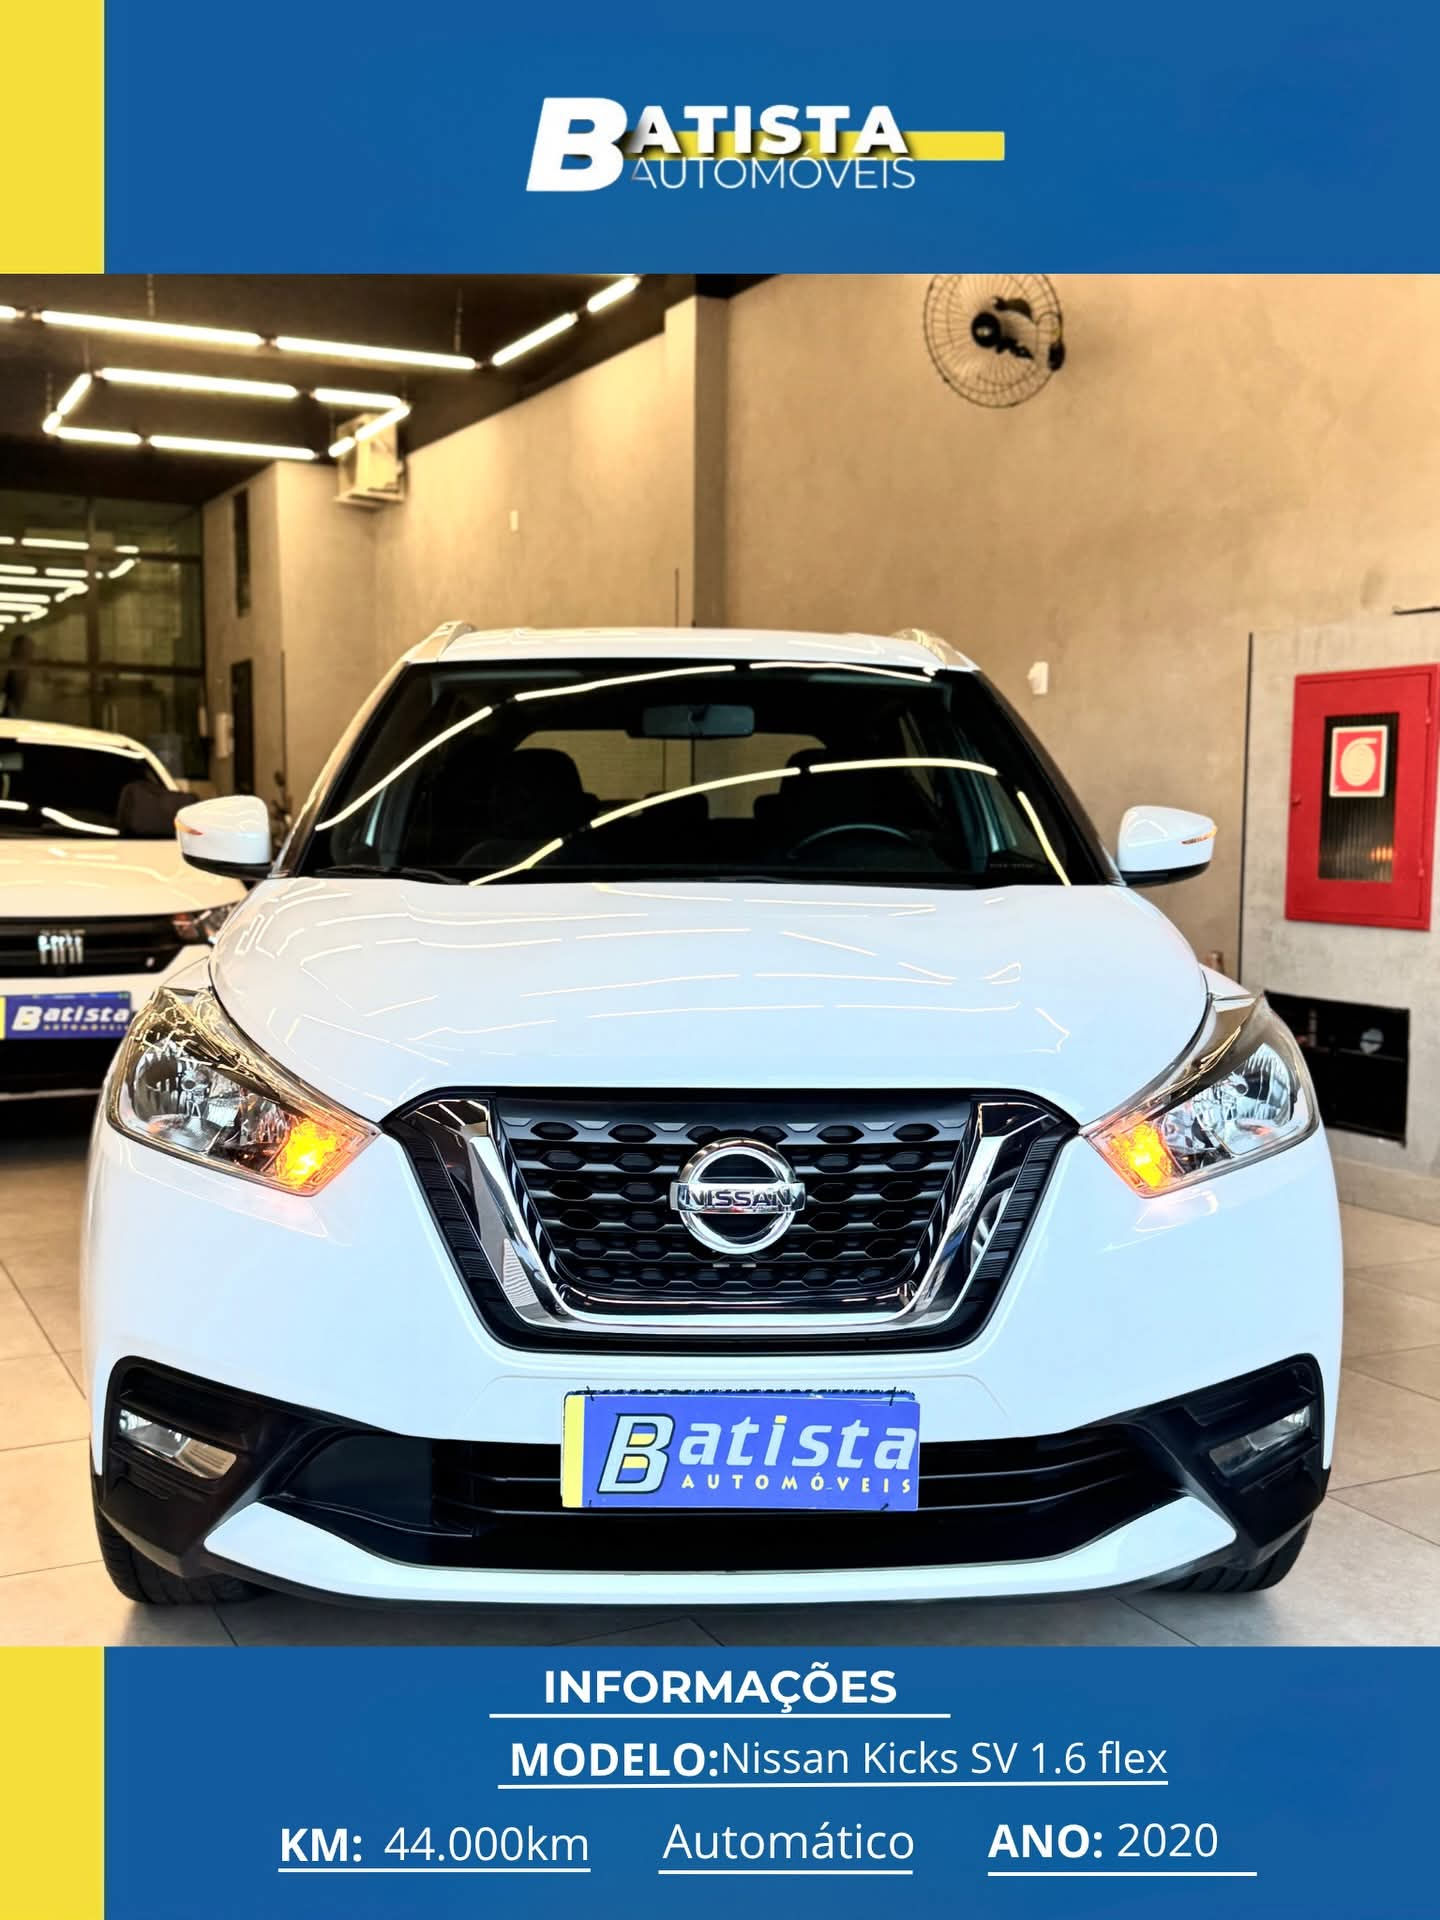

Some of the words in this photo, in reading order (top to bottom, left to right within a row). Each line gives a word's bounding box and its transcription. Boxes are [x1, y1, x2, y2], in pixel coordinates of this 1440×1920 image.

[12, 1005, 130, 1031] Batista
[683, 1187, 791, 1208] NISSAN
[597, 1413, 917, 1494] Batista
[681, 1472, 911, 1493] AUTOMÓVEIS
